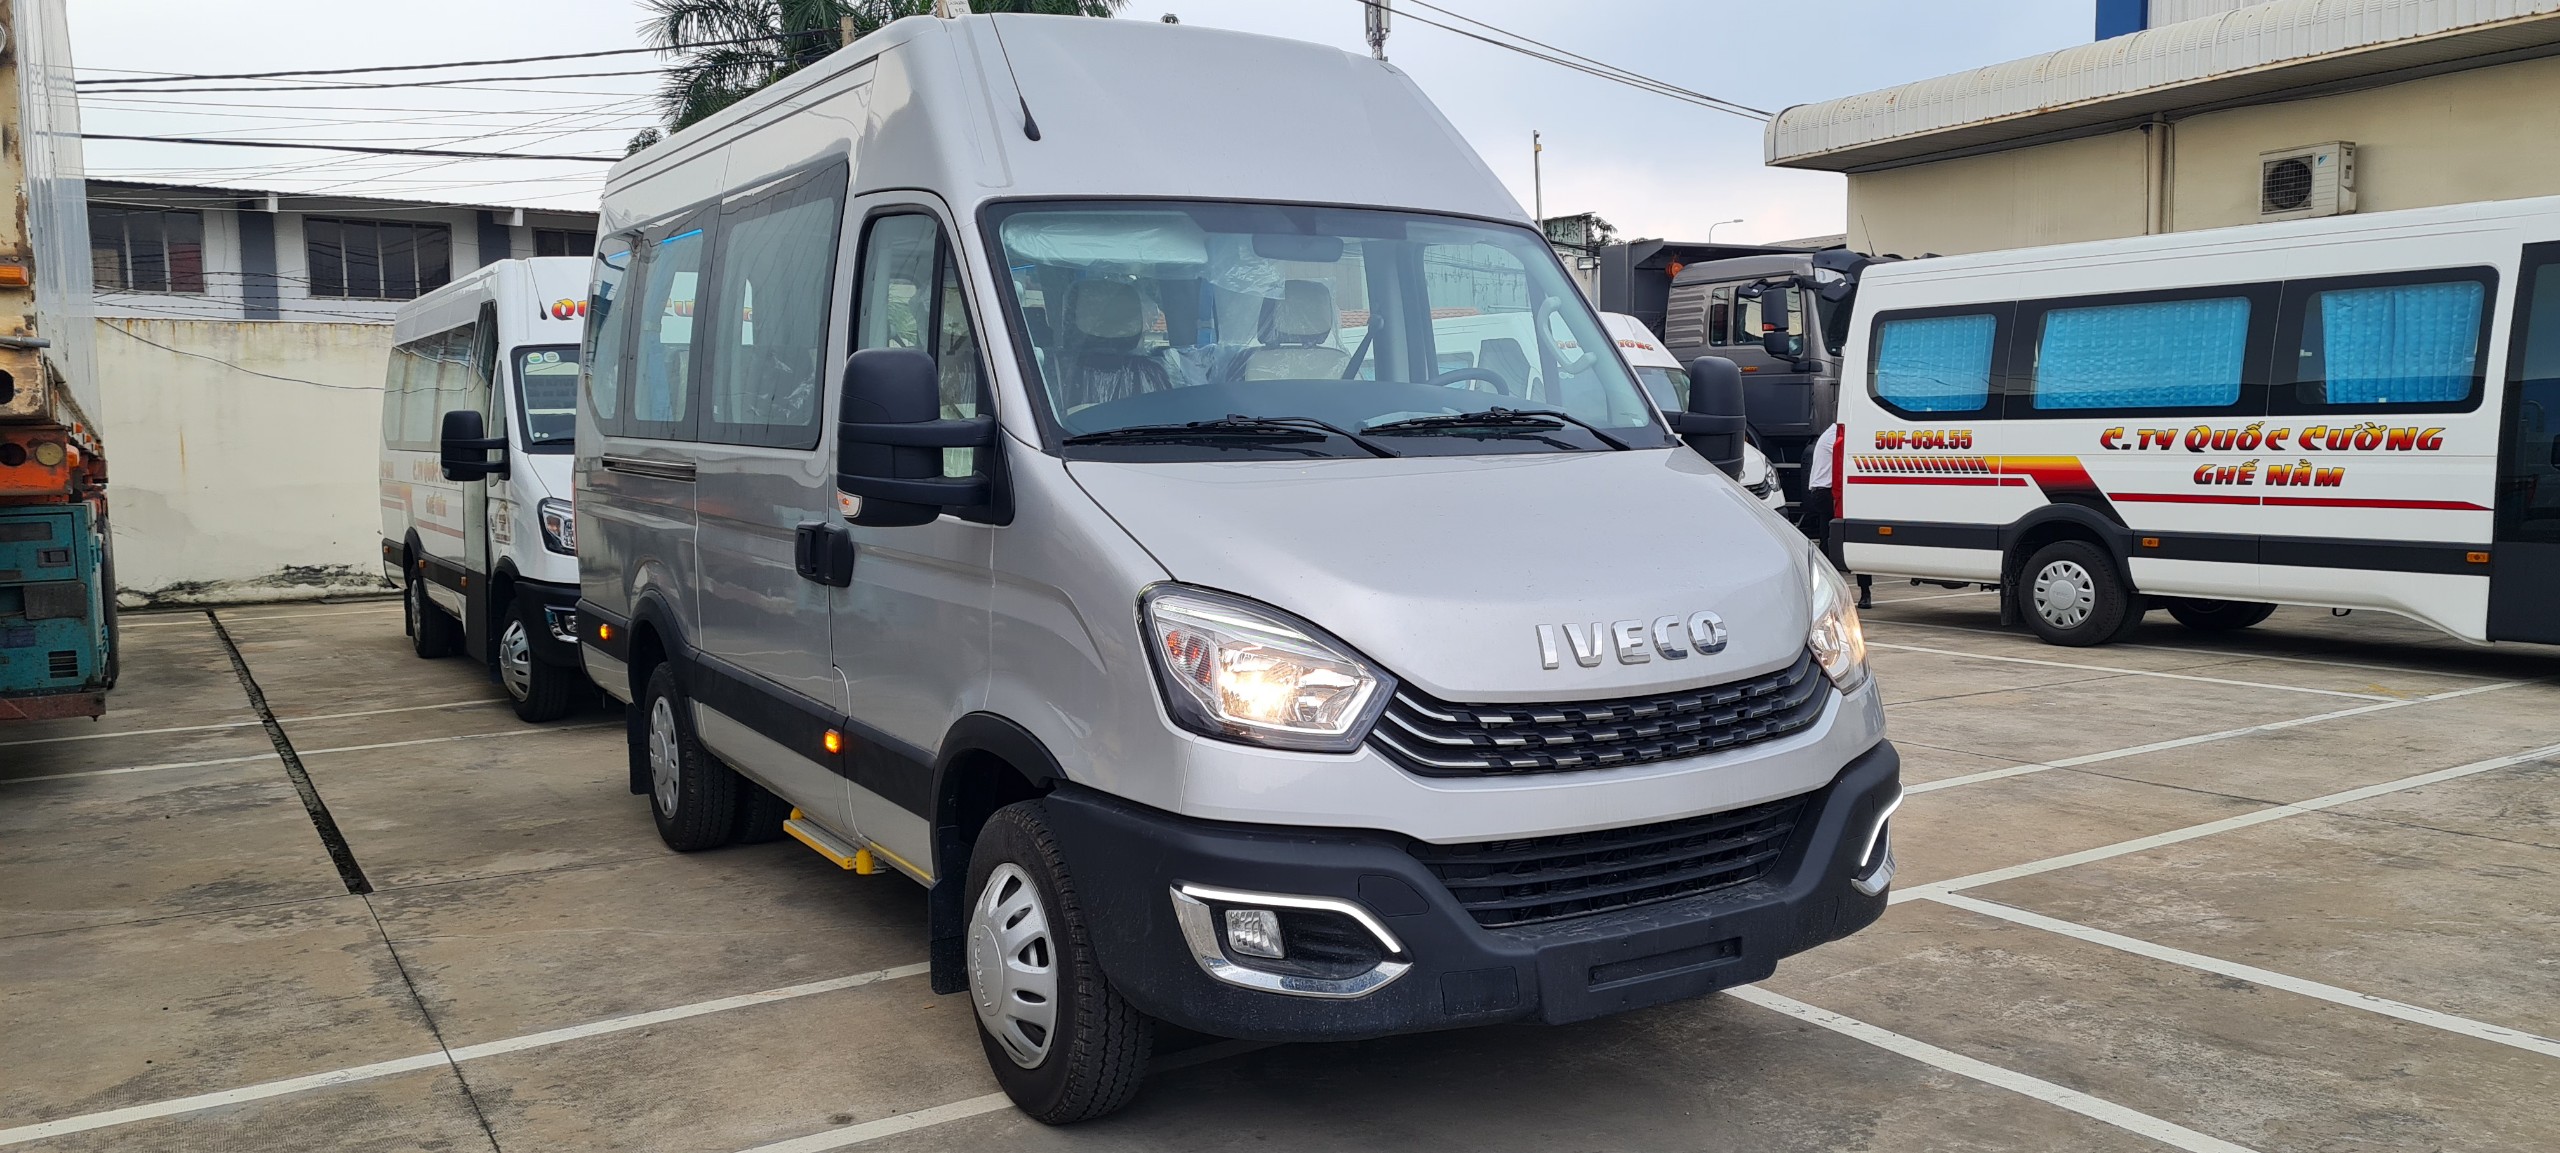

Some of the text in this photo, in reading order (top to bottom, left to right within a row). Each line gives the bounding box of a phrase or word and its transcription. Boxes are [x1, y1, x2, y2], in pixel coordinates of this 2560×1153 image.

[1875, 429, 1973, 450] 50F-034.55
[2184, 421, 2291, 453] QUỐC
[2298, 421, 2447, 451] CƯỜNG
[2193, 458, 2346, 487] GHẾ NẰM
[1535, 610, 1728, 670] IVECO
